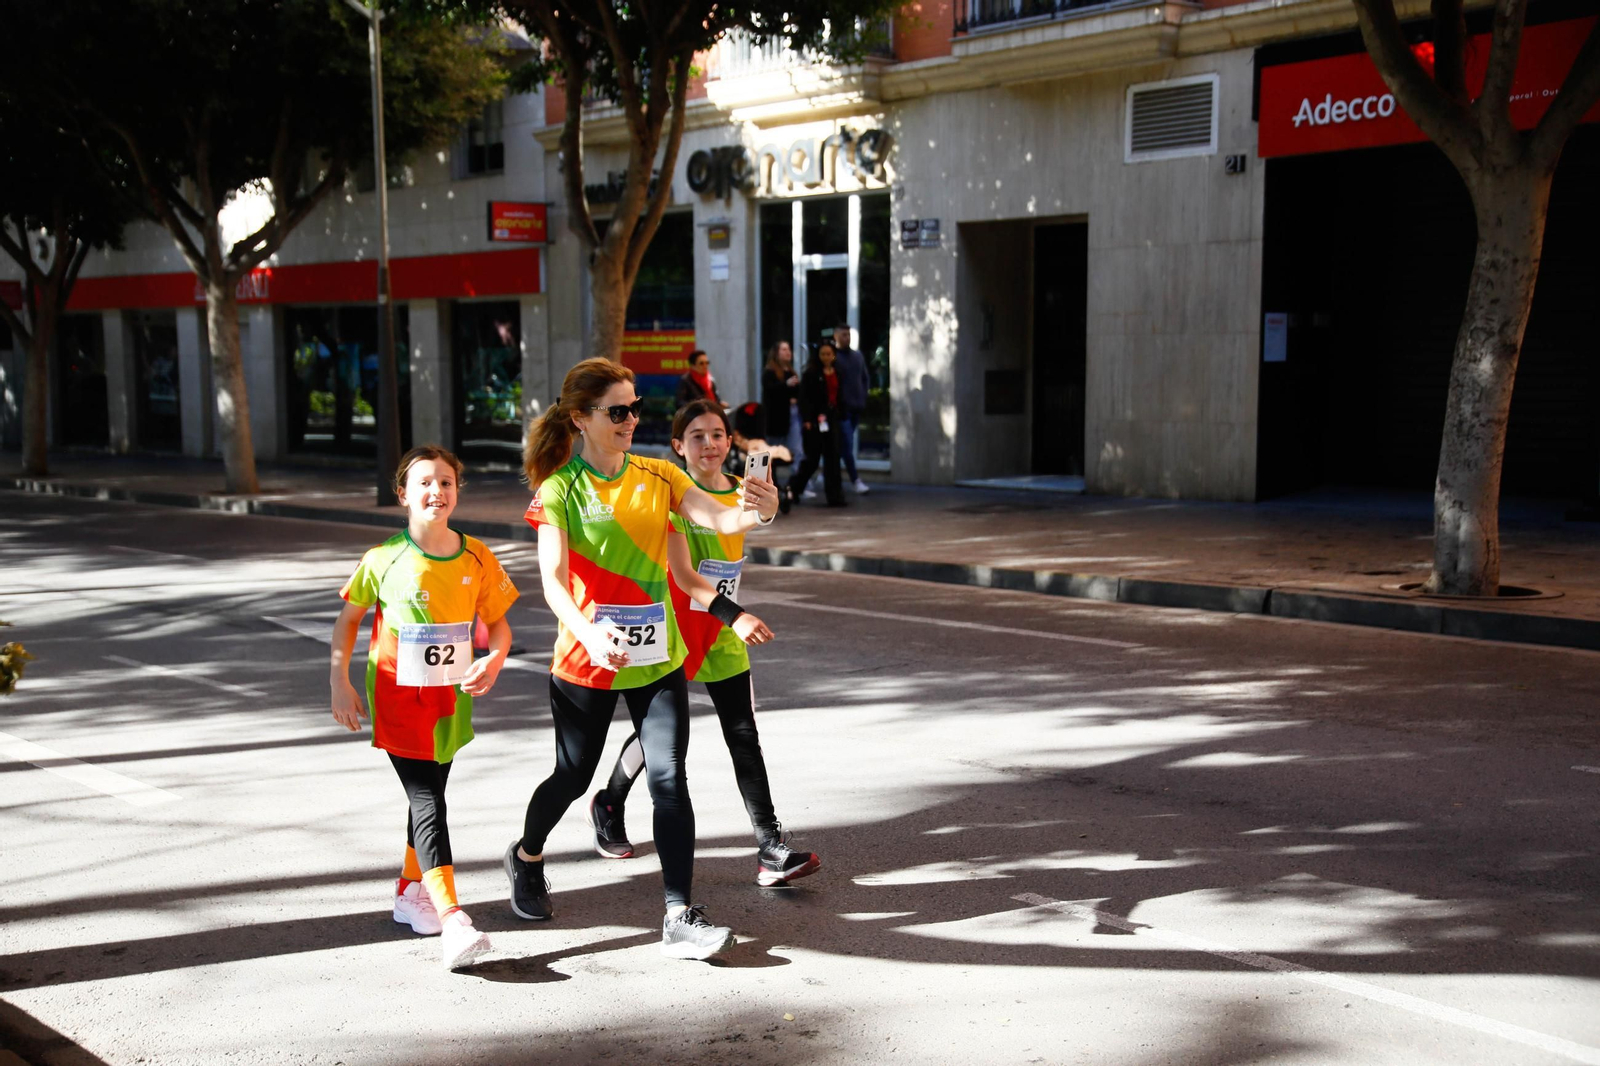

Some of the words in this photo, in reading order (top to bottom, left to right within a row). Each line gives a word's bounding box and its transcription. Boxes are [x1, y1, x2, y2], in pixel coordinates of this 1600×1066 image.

[1292, 93, 1396, 128] Adecco
[716, 578, 736, 596] 63
[424, 644, 455, 666] 62
